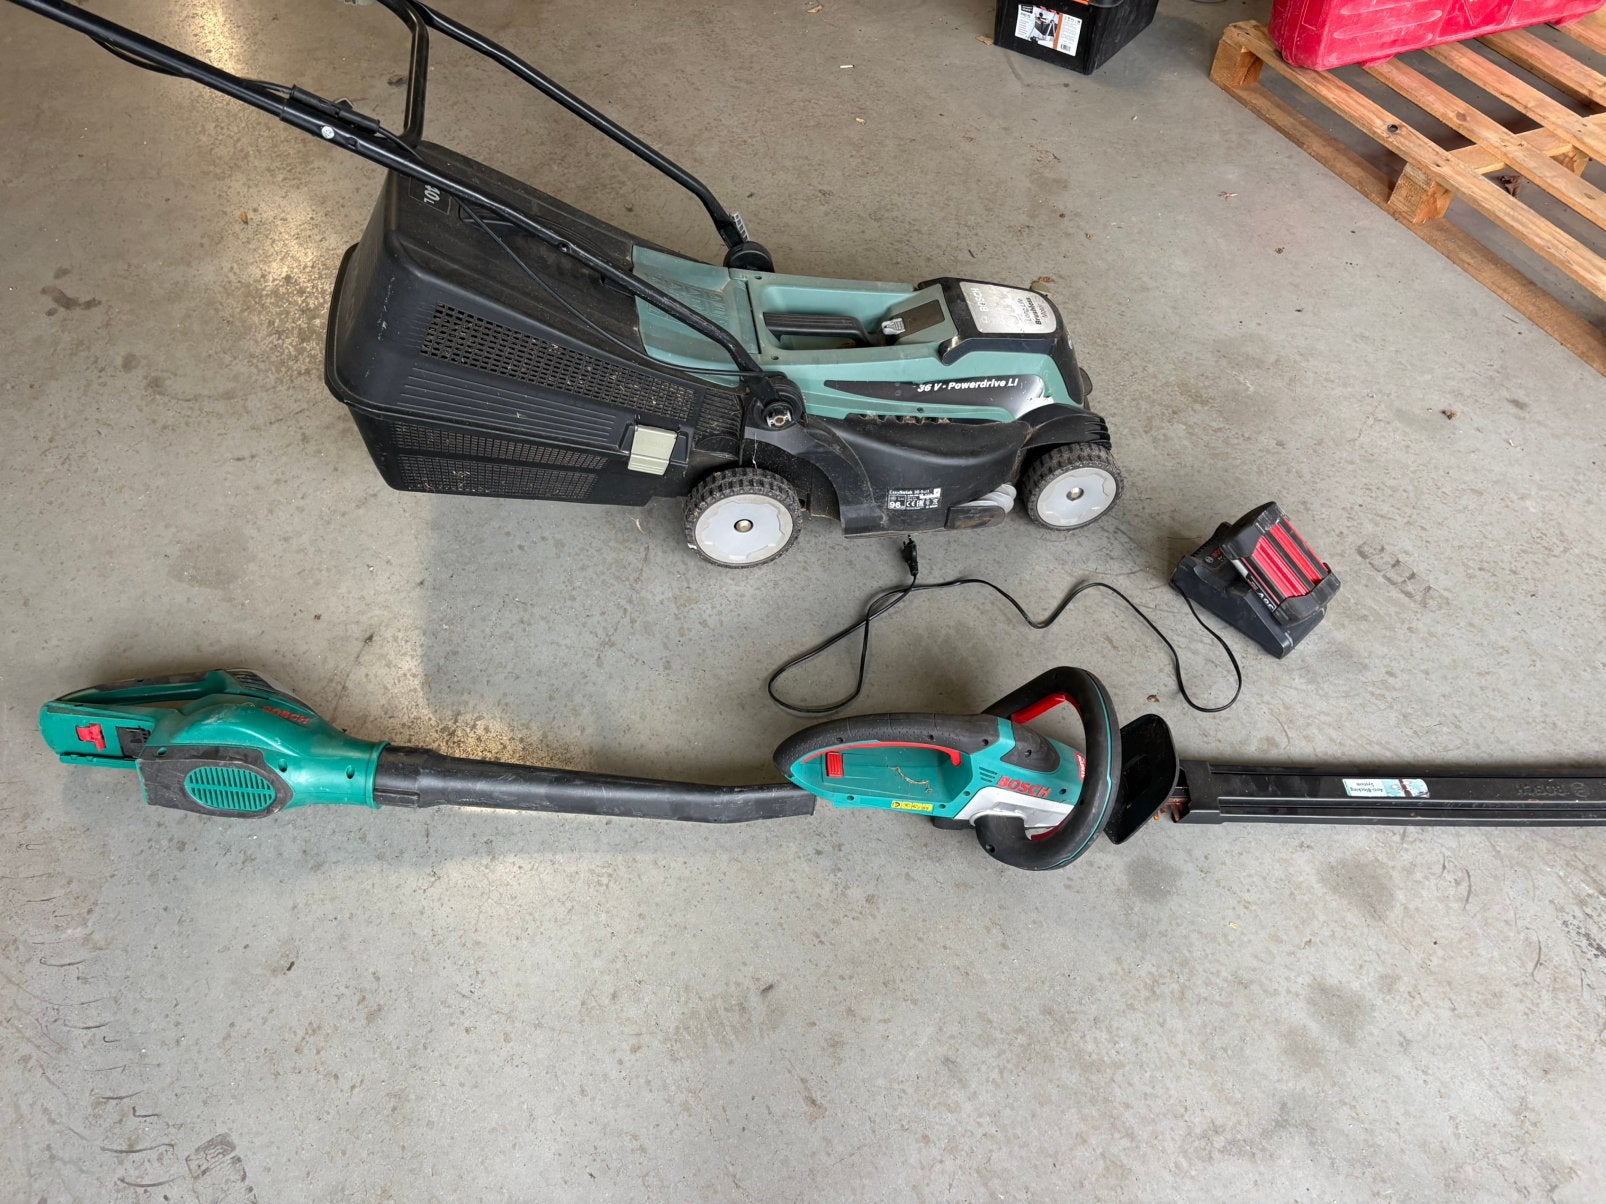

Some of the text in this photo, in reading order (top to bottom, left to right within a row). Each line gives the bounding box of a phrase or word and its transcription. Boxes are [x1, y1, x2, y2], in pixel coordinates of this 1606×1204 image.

[917, 383, 932, 393] 36
[947, 378, 1007, 391] Powerdrive
[997, 776, 1052, 798] BOSCH
